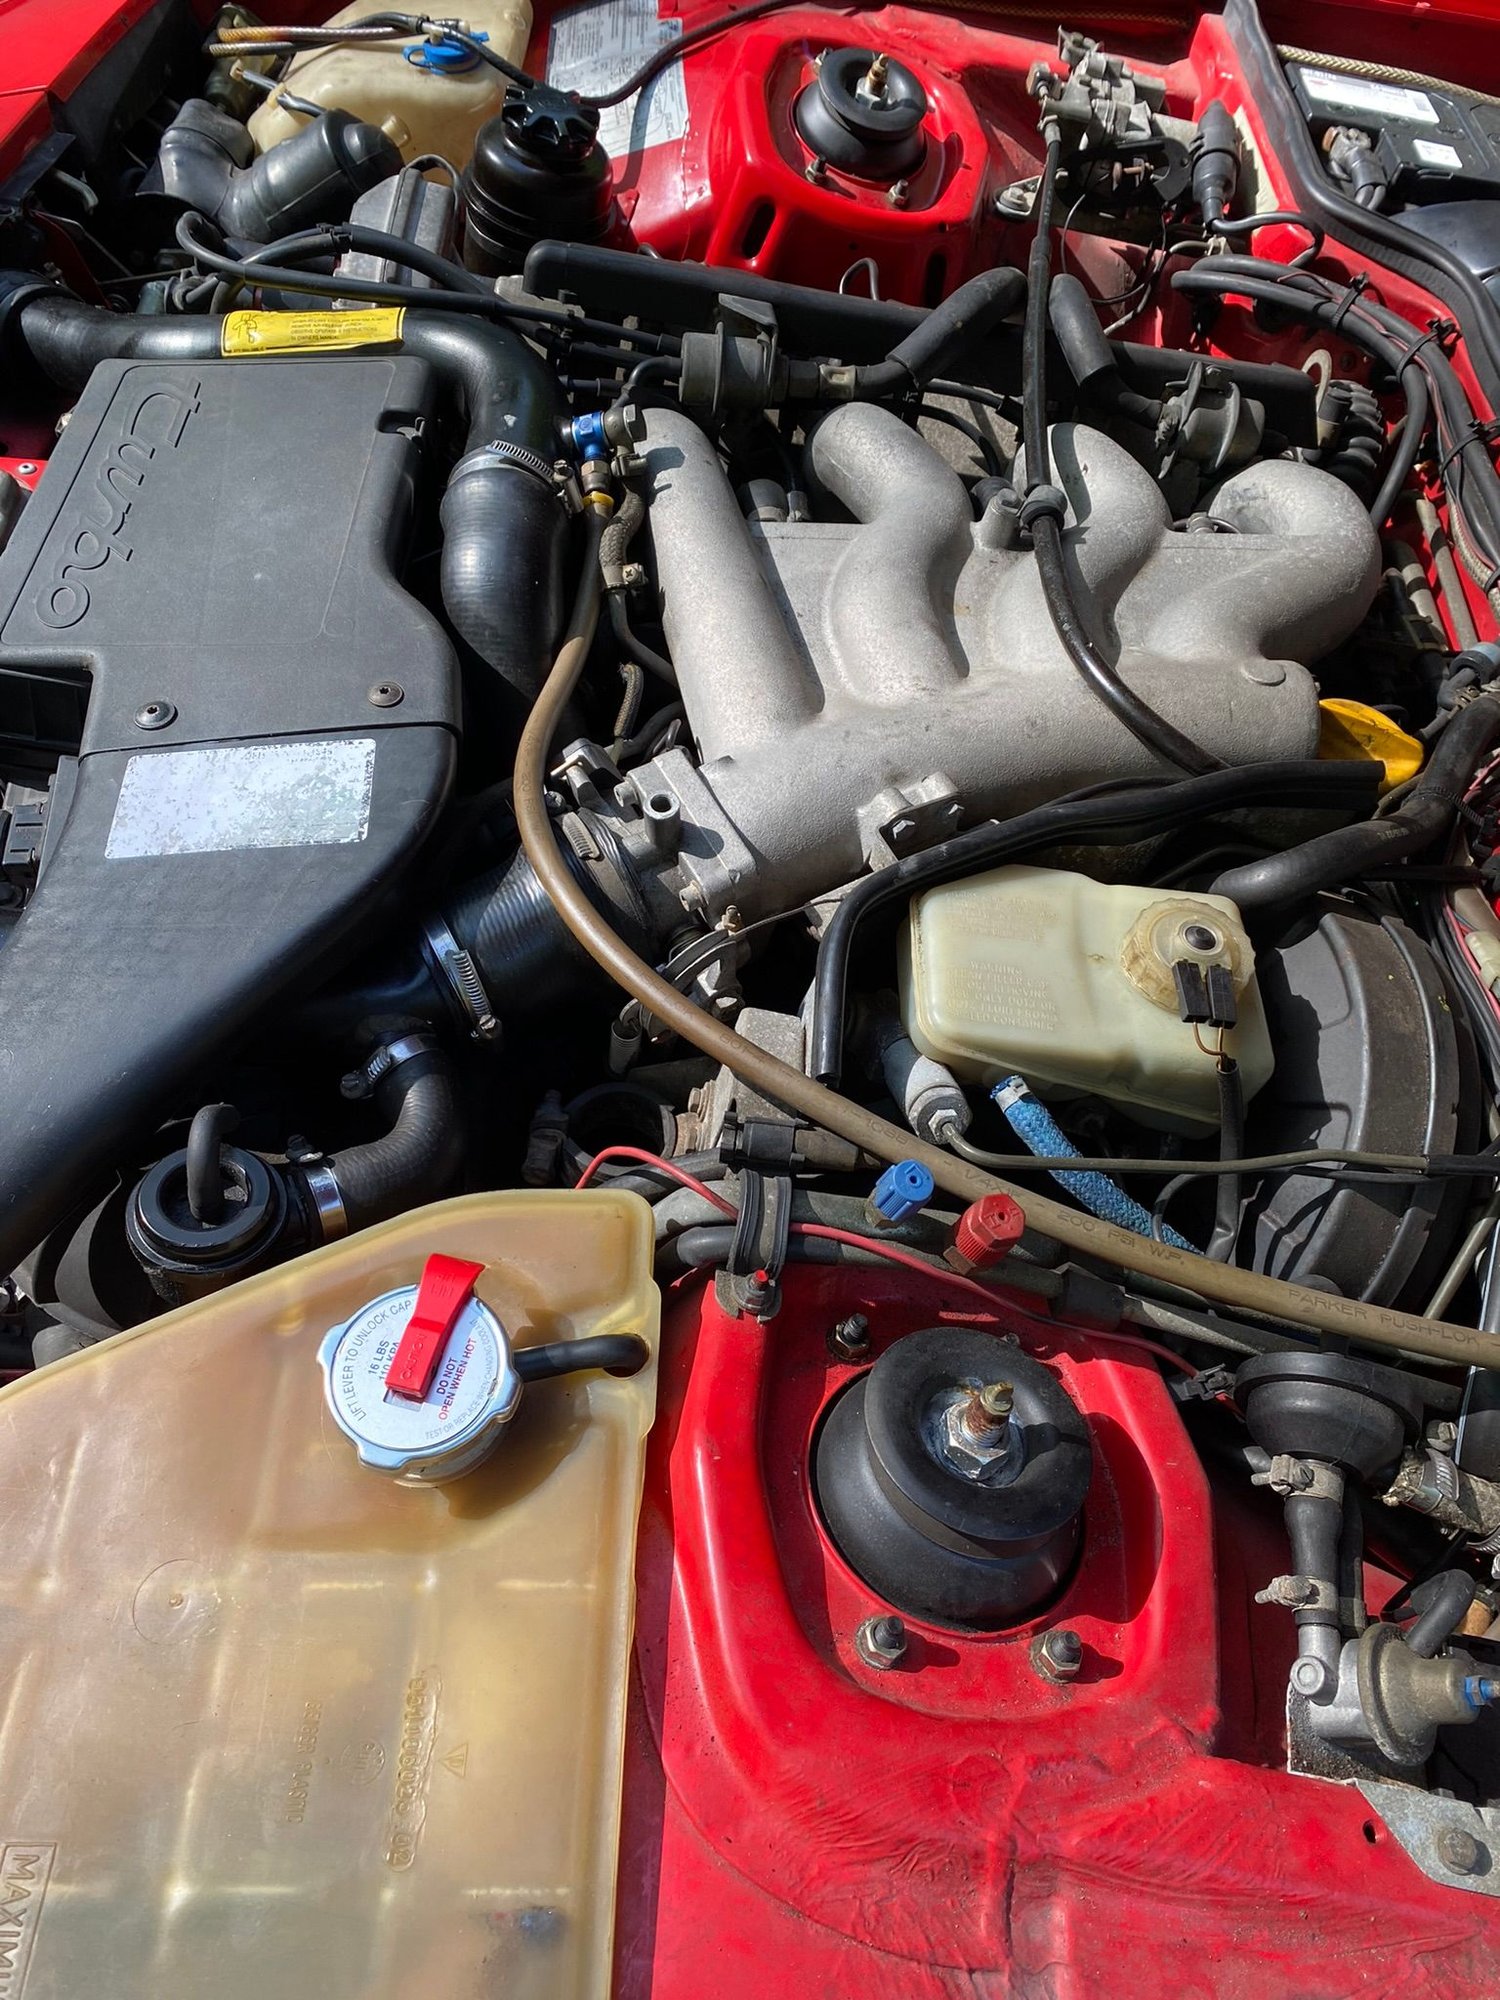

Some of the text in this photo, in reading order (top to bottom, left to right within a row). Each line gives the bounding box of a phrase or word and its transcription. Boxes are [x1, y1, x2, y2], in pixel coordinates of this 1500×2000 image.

[1056, 1210, 1096, 1232] 200
[1106, 1230, 1137, 1248] PSI
[1288, 1289, 1480, 1345] PARKER PUSH-LOK
[342, 1300, 411, 1421] LIFT LEVER TO UNLOCK CAP
[368, 1340, 390, 1375] 16 LBS
[436, 1357, 457, 1395] DO NOT
[439, 1338, 477, 1420] OPEN WHEN HOT
[425, 1426, 443, 1440] TEST
[443, 1421, 454, 1432] OR
[0, 1854, 40, 2000] MAXIM
